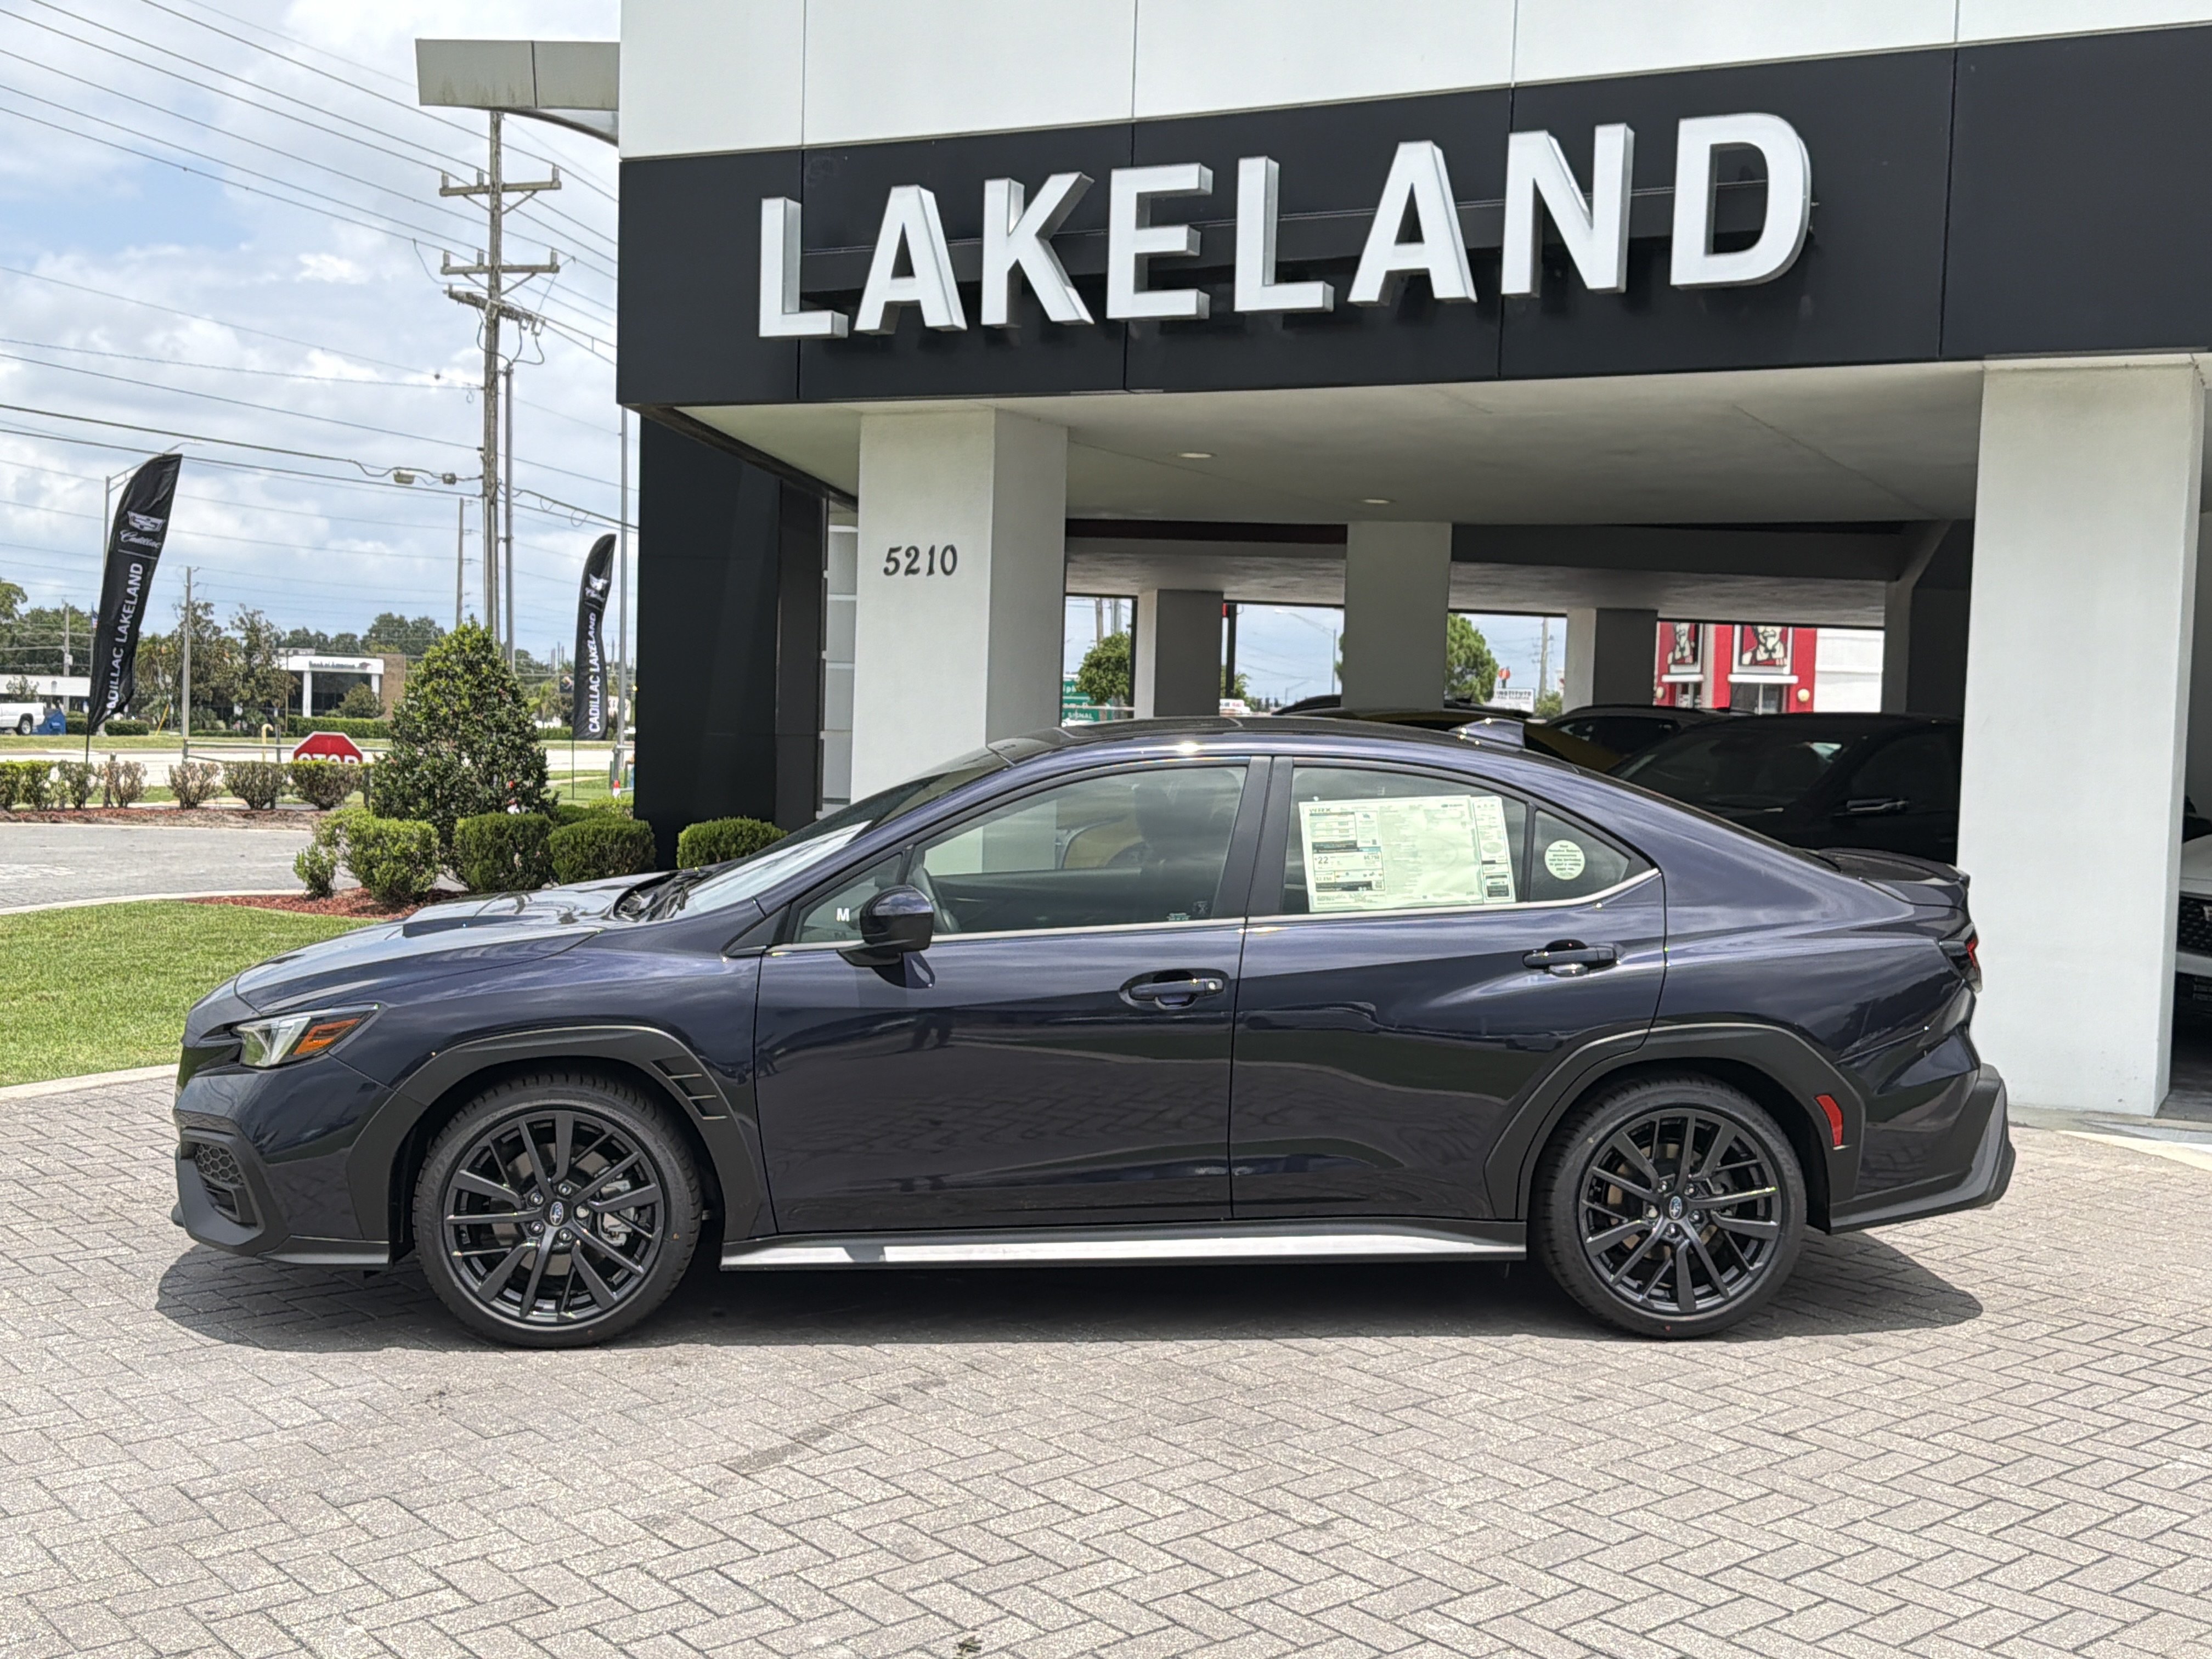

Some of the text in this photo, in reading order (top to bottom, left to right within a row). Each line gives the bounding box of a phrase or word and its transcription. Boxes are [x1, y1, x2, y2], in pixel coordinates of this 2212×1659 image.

[758, 112, 1812, 338] LAKELAND
[883, 544, 958, 577] 5210
[106, 563, 144, 715] ADILLAC LAKELAND
[588, 612, 600, 673] LAKELAND
[589, 675, 600, 733] CADILLAC
[836, 908, 850, 922] M
